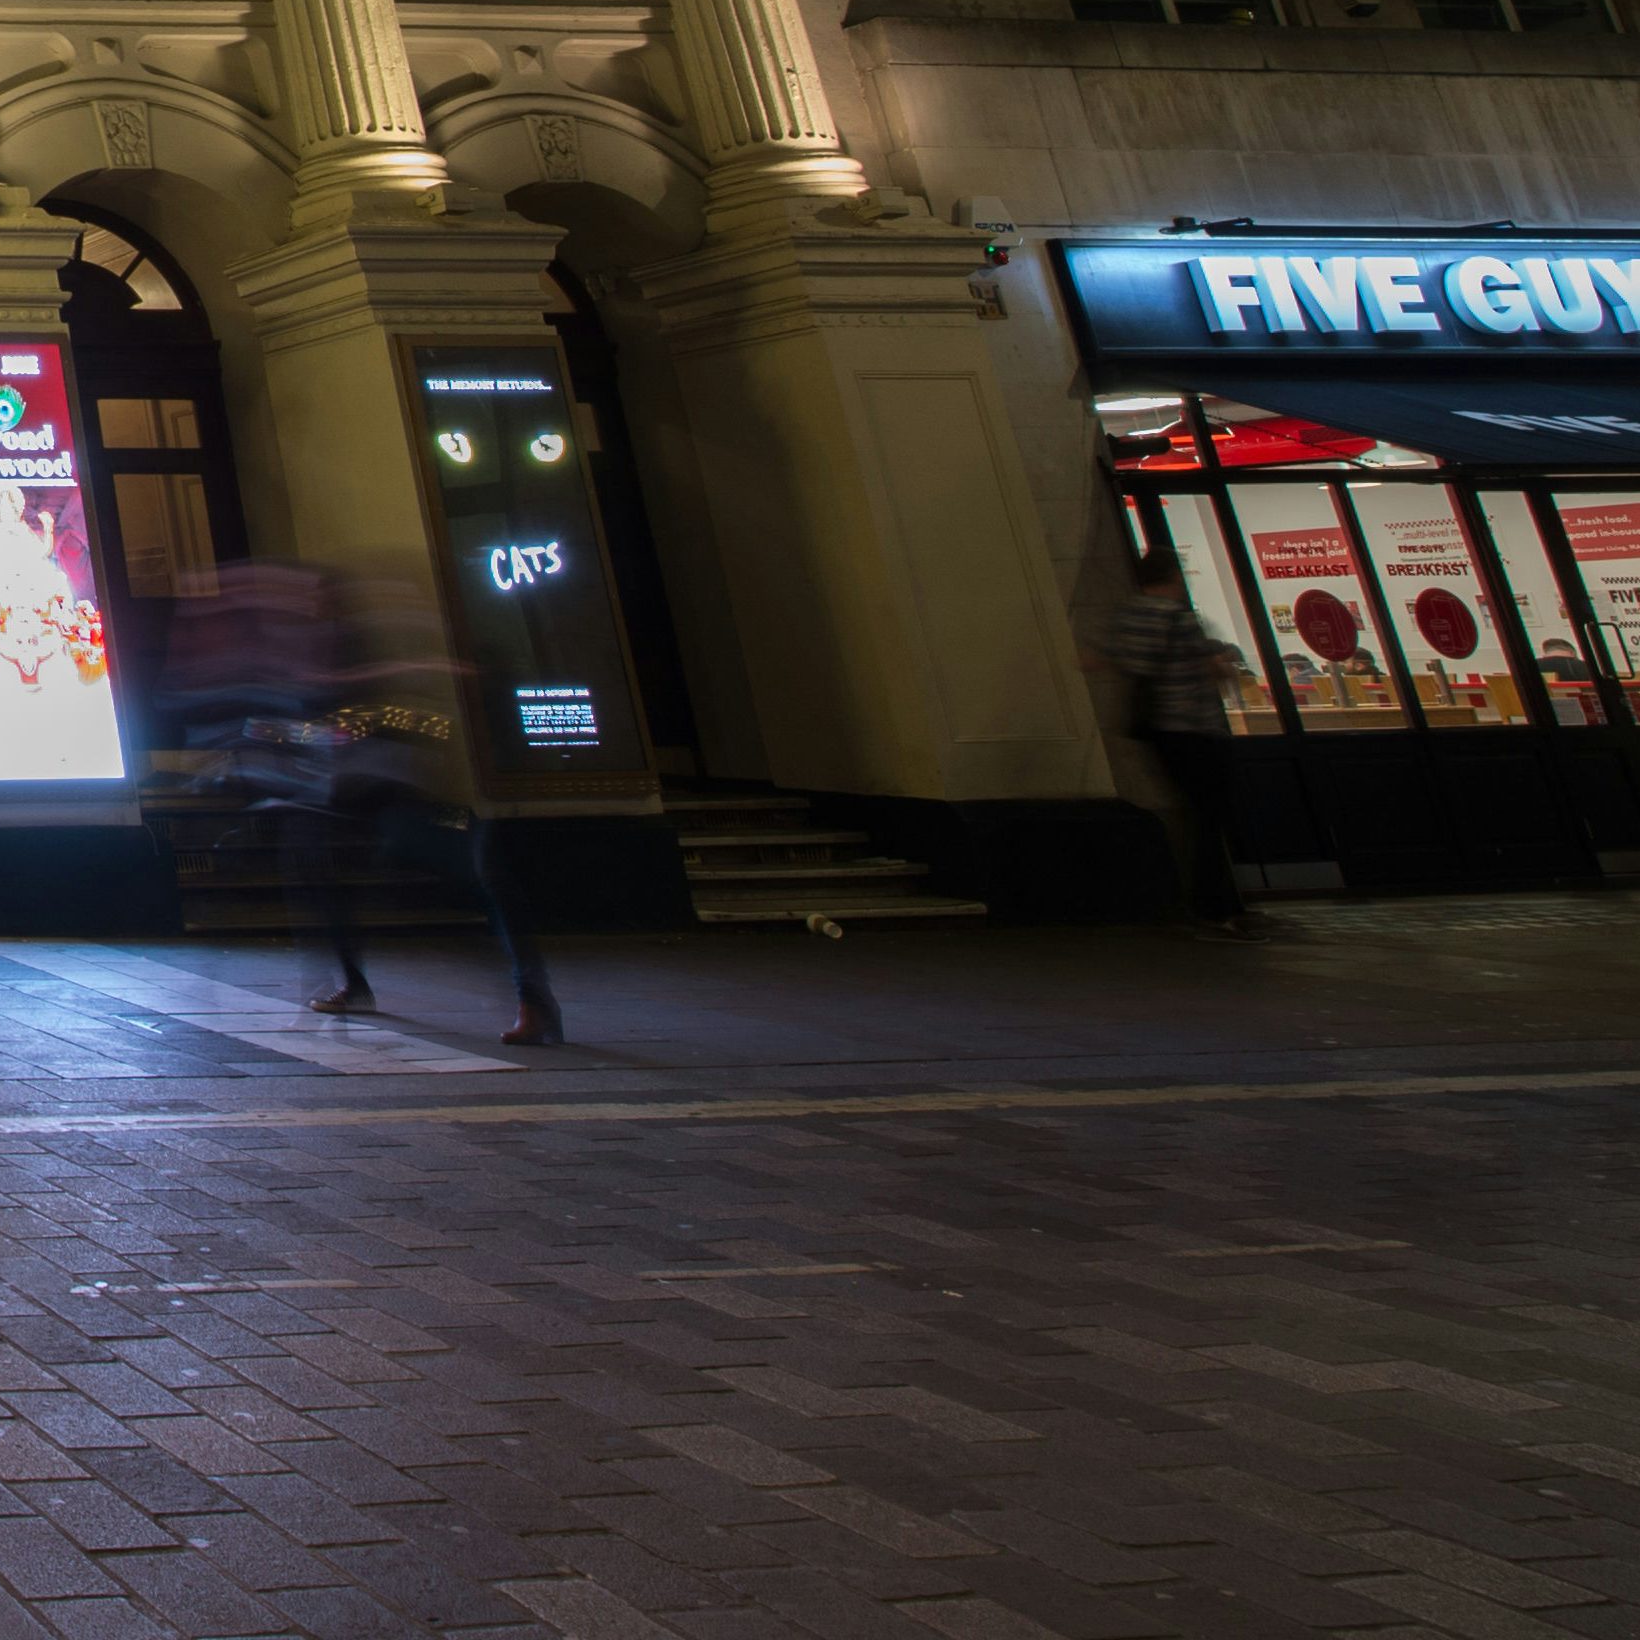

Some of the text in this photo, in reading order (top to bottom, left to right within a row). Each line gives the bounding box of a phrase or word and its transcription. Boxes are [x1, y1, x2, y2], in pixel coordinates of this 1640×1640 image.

[1190, 255, 1441, 334] FIVE
[491, 541, 562, 590] CATS
[1265, 563, 1349, 579] BREAKFAST
[1386, 562, 1468, 577] BREAKFAST
